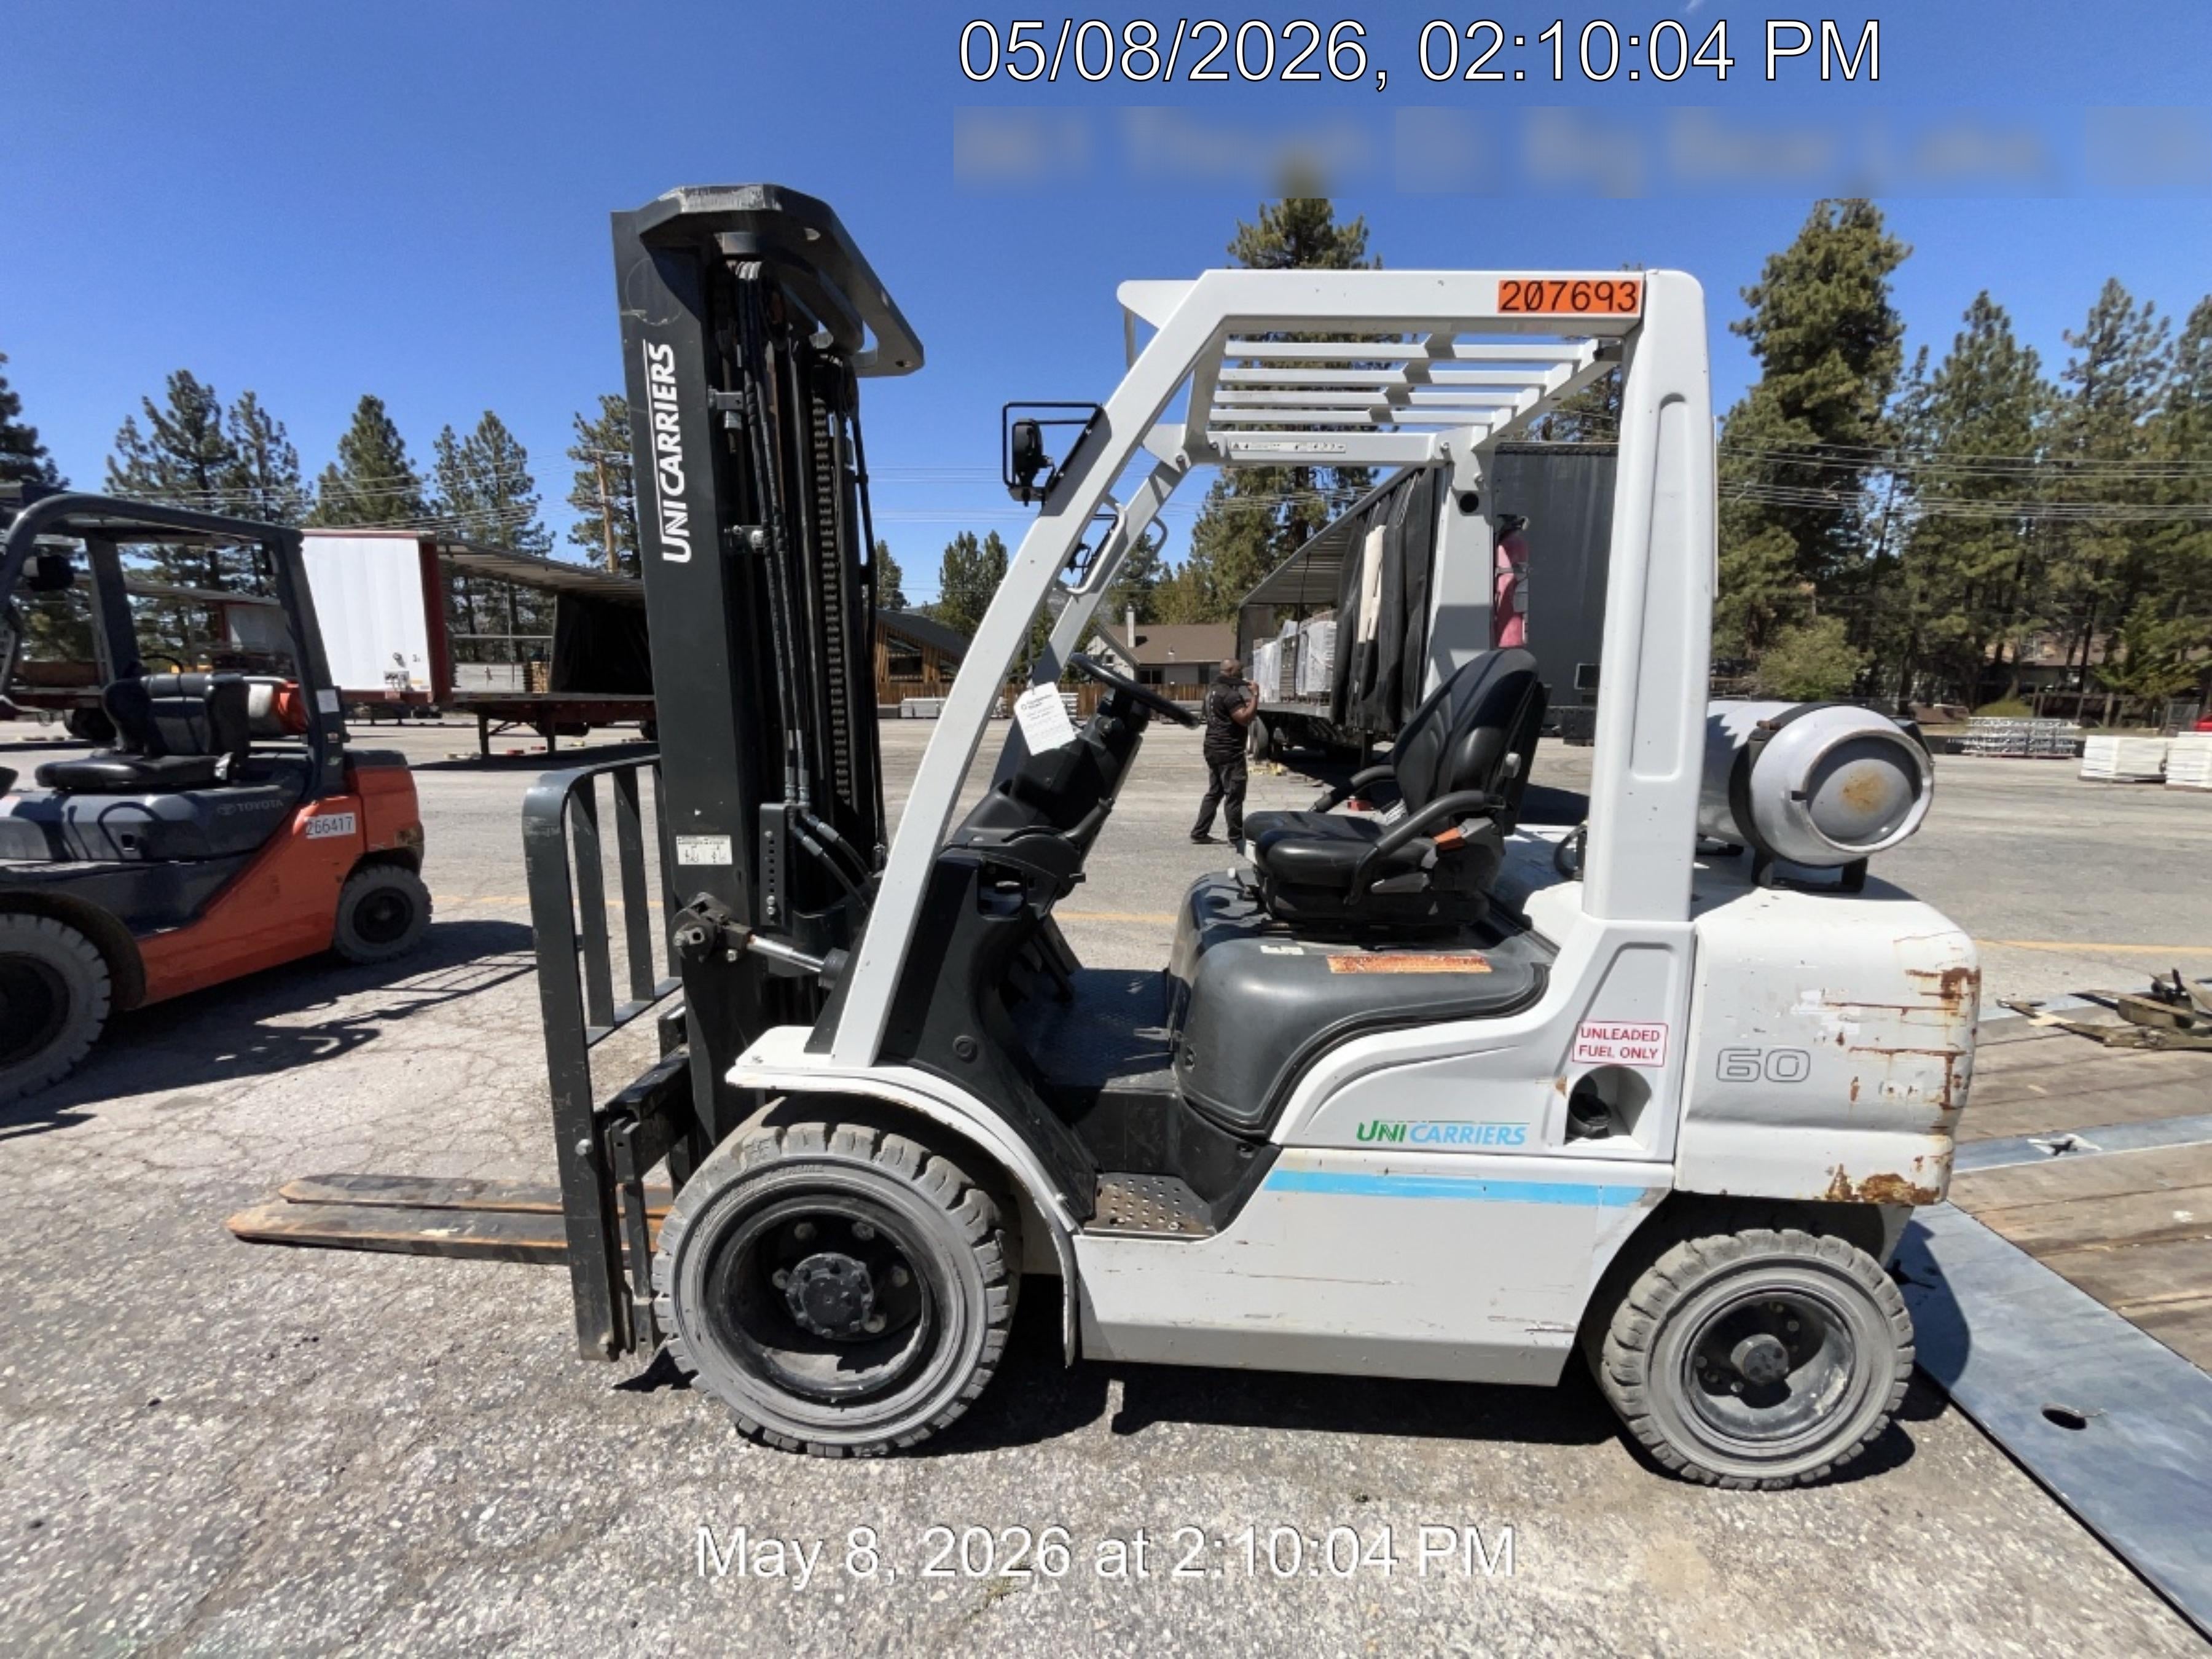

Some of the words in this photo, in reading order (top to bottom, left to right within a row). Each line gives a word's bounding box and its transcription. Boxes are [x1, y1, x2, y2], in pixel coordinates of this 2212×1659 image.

[1501, 281, 1636, 312] 207693
[237, 799, 284, 812] TOYOTA
[306, 815, 353, 836] 266417
[1581, 1027, 1660, 1043] UNLEADED
[1579, 1045, 1613, 1059] FUEL
[1619, 1046, 1659, 1061] ONLY
[1716, 1048, 1811, 1083] 60
